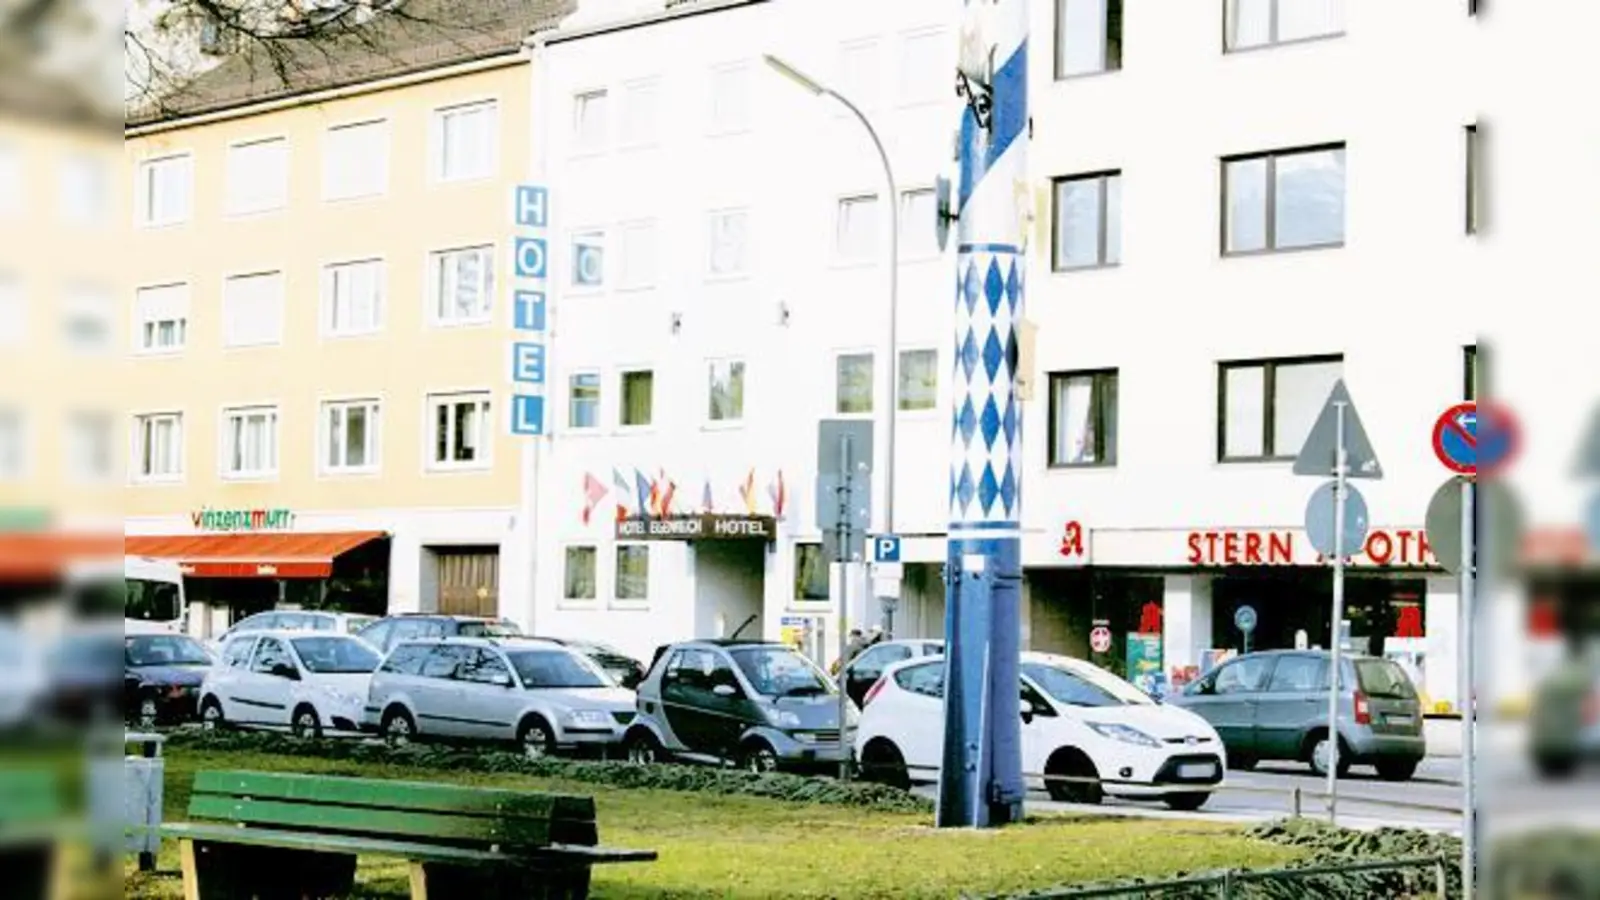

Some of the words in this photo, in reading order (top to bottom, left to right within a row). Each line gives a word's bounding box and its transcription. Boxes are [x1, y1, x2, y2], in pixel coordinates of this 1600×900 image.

[516, 188, 544, 432] HOTEL
[715, 519, 769, 535] HOTEL
[879, 540, 896, 559] P
[1187, 531, 1293, 564] STERN
